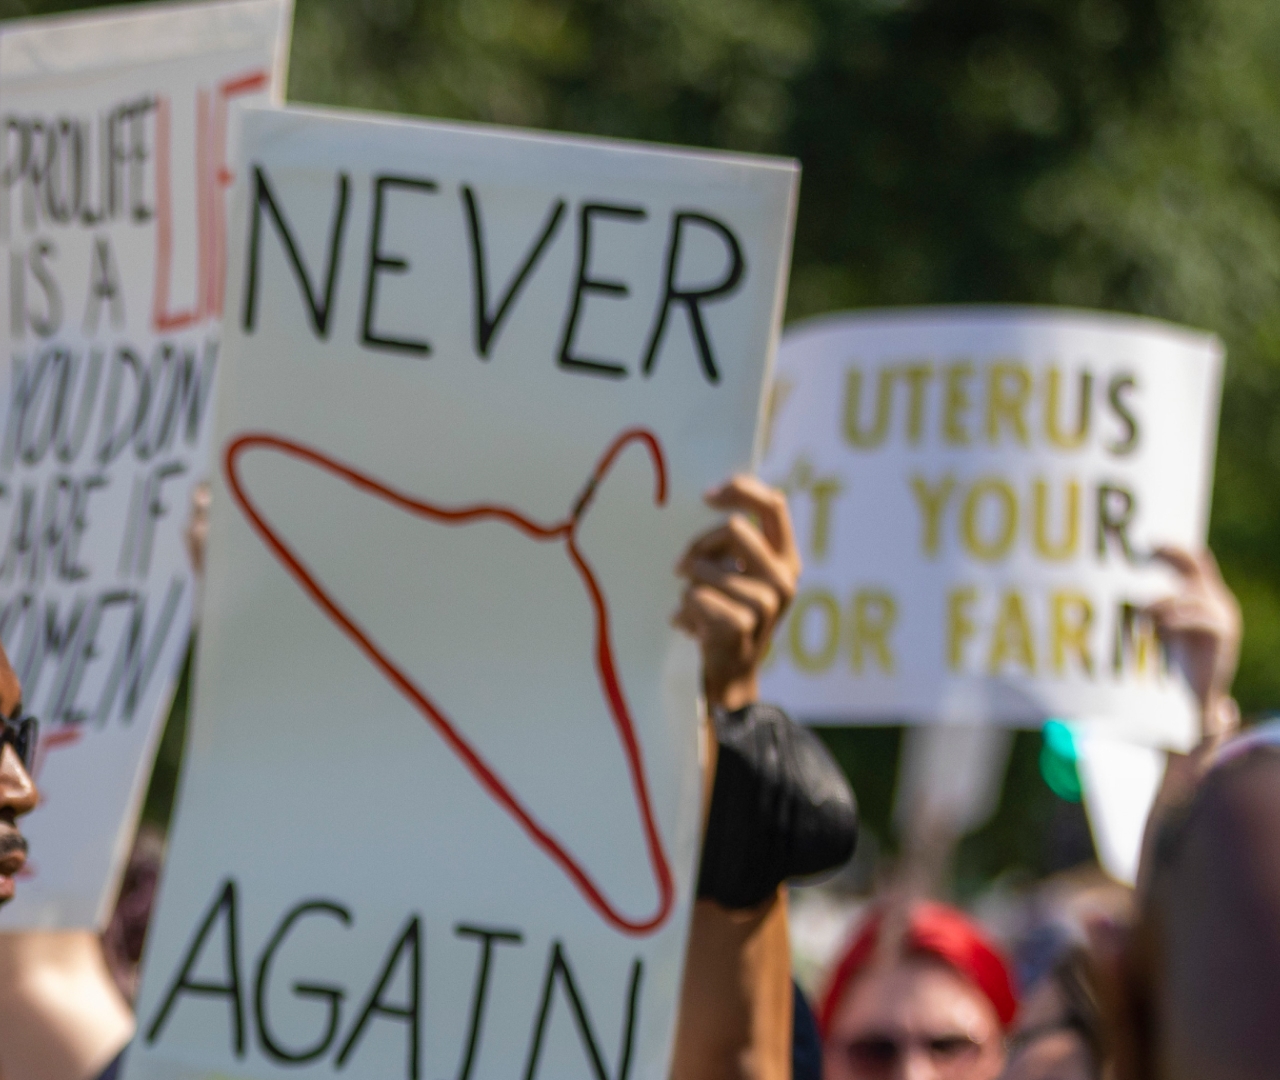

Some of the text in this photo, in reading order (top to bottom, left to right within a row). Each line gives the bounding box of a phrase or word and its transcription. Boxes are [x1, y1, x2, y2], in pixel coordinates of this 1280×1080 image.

[10, 234, 127, 340] IS A
[243, 160, 748, 384] NEVER
[842, 356, 1144, 459] UTERUS
[114, 457, 188, 585] IF
[908, 472, 1140, 568] YOUR
